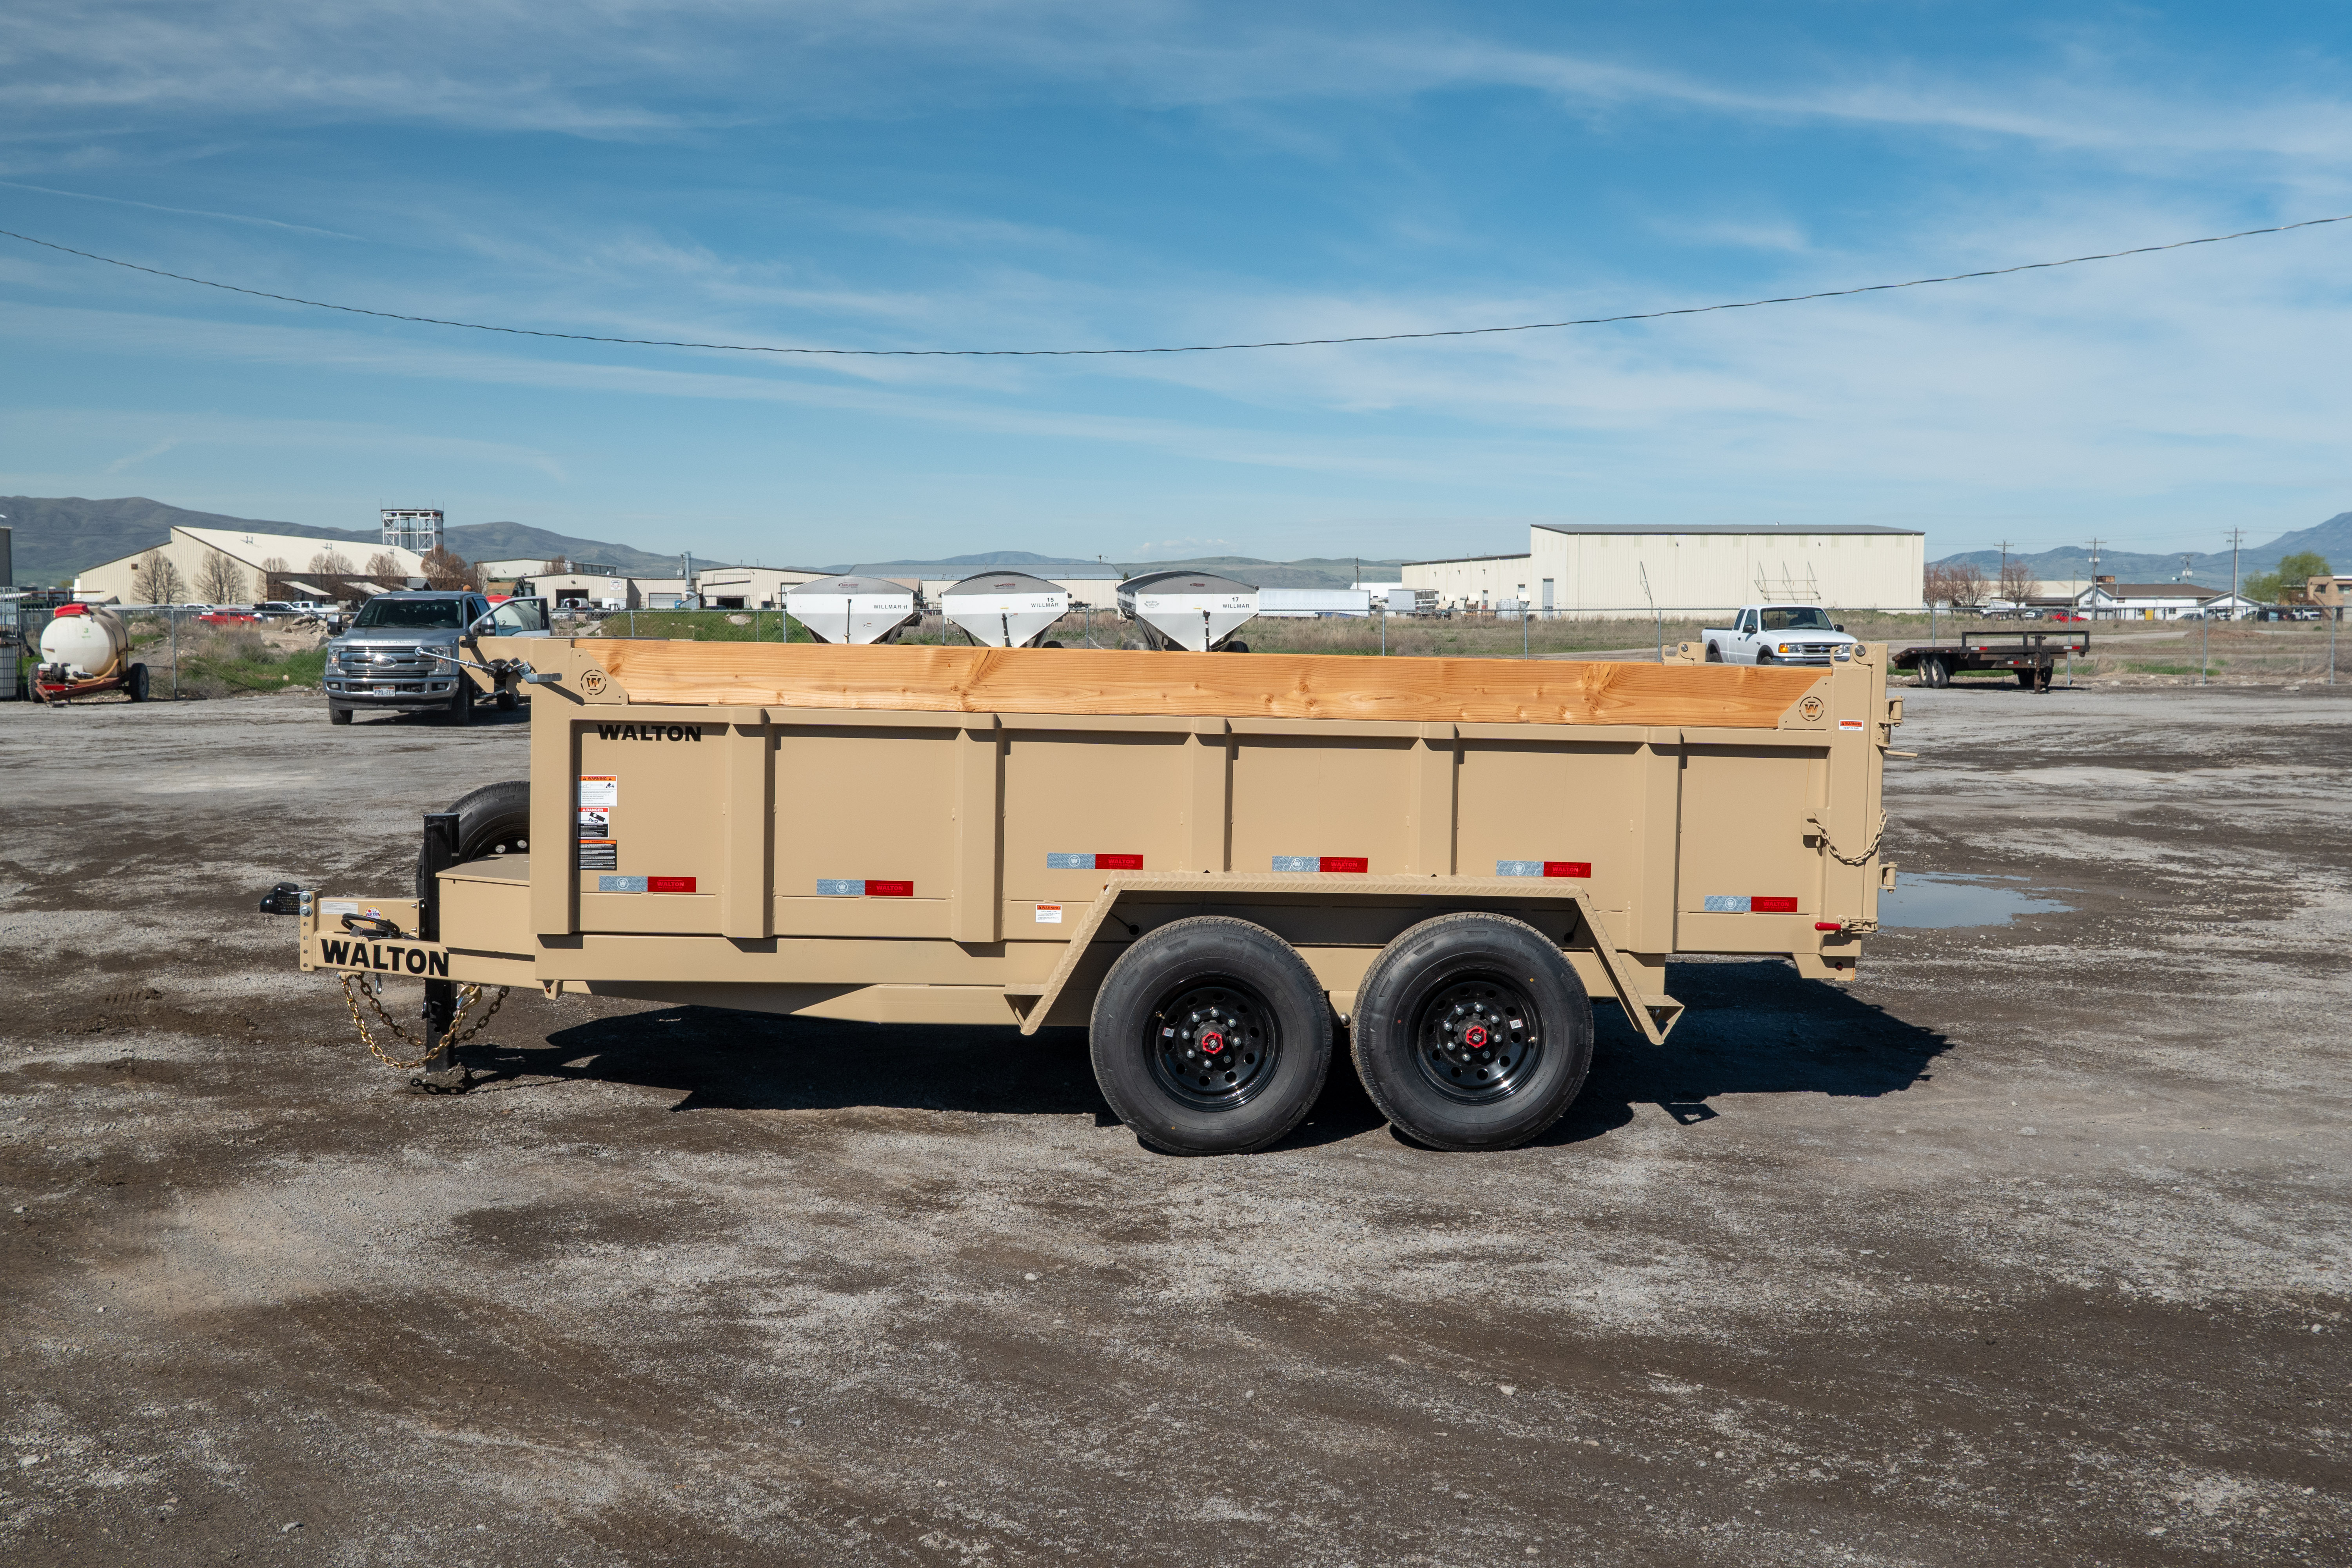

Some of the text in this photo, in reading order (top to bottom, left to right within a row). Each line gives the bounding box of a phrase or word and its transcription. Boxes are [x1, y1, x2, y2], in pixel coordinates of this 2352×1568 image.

[597, 724, 701, 742] WALTON
[320, 939, 449, 977] WALTON
[1533, 1076, 1544, 1090] TRAILER
[1522, 1088, 1535, 1101] SERVICE
